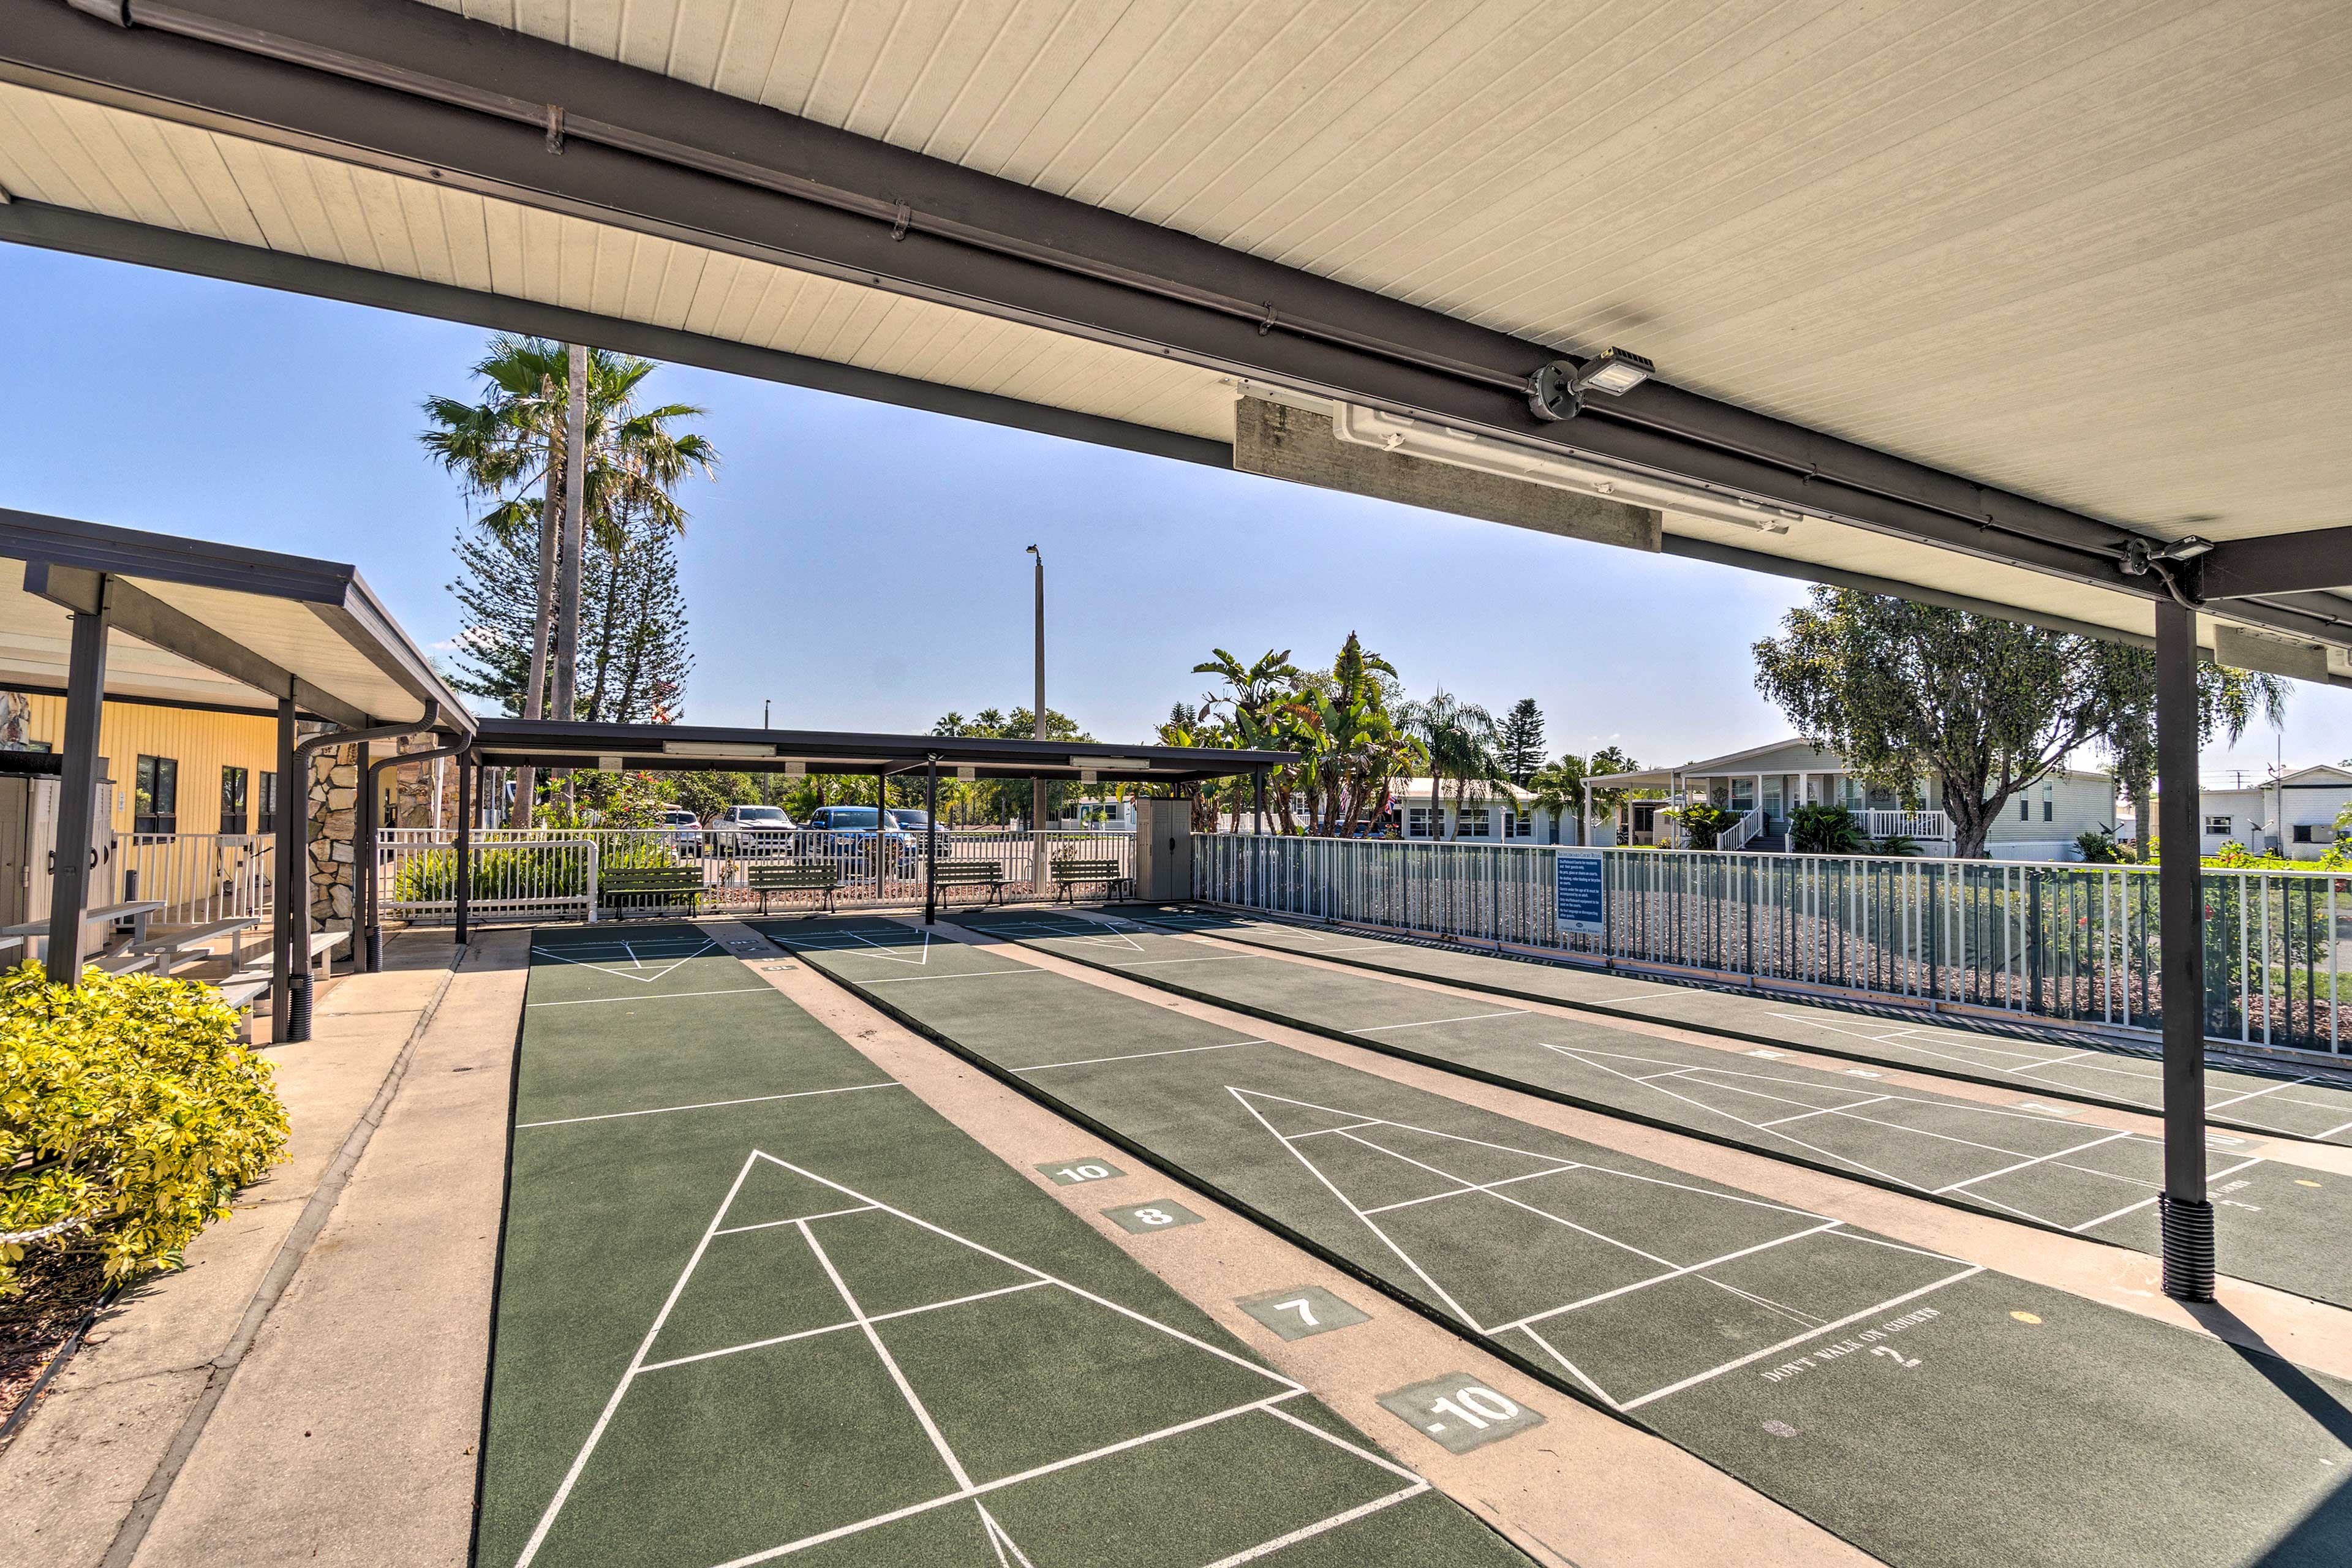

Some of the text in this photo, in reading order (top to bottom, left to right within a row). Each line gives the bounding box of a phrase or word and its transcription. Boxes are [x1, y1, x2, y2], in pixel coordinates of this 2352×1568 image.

[1056, 1165, 1109, 1182] 10
[1134, 1208, 1173, 1225] 8
[1273, 1298, 1320, 1327] 7
[1760, 1306, 1941, 1382] DON'T WALK ON COURTS
[1869, 1345, 1923, 1368] 2
